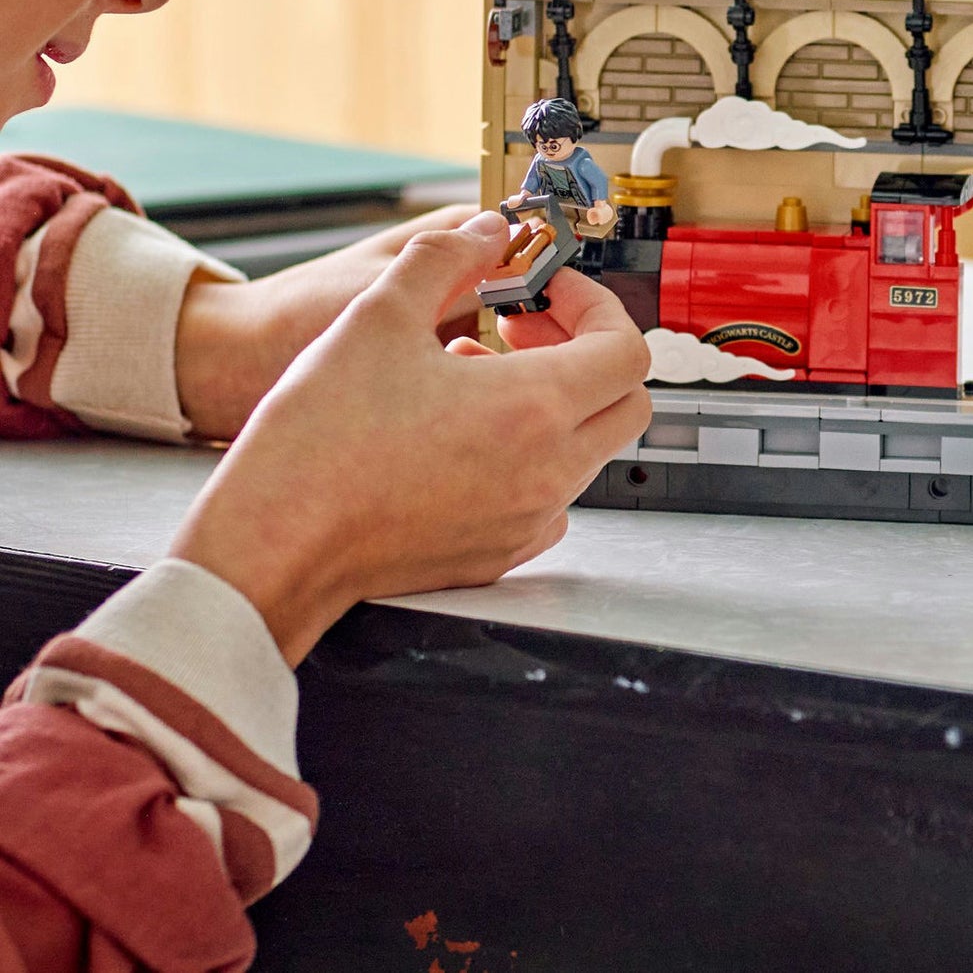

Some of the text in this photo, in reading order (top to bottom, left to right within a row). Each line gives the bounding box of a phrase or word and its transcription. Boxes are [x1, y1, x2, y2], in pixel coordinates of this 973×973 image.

[893, 290, 934, 304] 5972
[707, 328, 794, 349] HOGWARTS CASTLE
